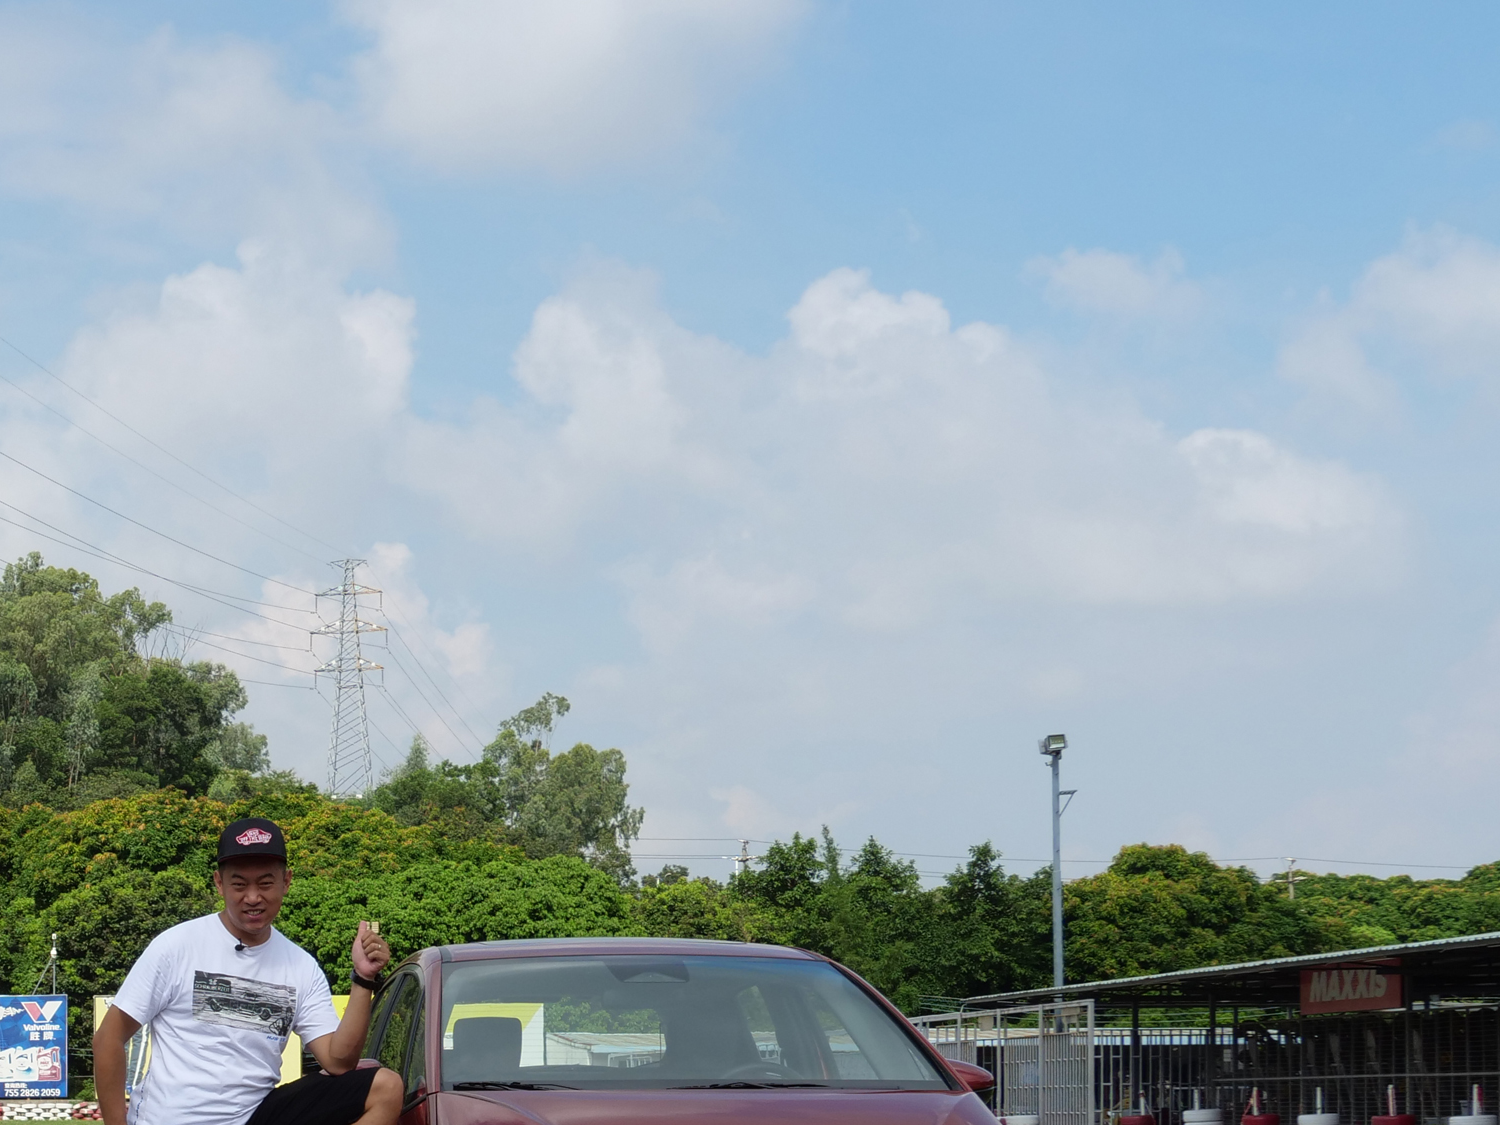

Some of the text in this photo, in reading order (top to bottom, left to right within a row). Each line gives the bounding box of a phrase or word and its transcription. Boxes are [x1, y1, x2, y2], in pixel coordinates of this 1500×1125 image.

[1309, 969, 1388, 1002] MAXXIS
[4, 1088, 19, 1097] 755
[20, 1088, 40, 1097] 2826
[40, 1088, 61, 1097] 2059
